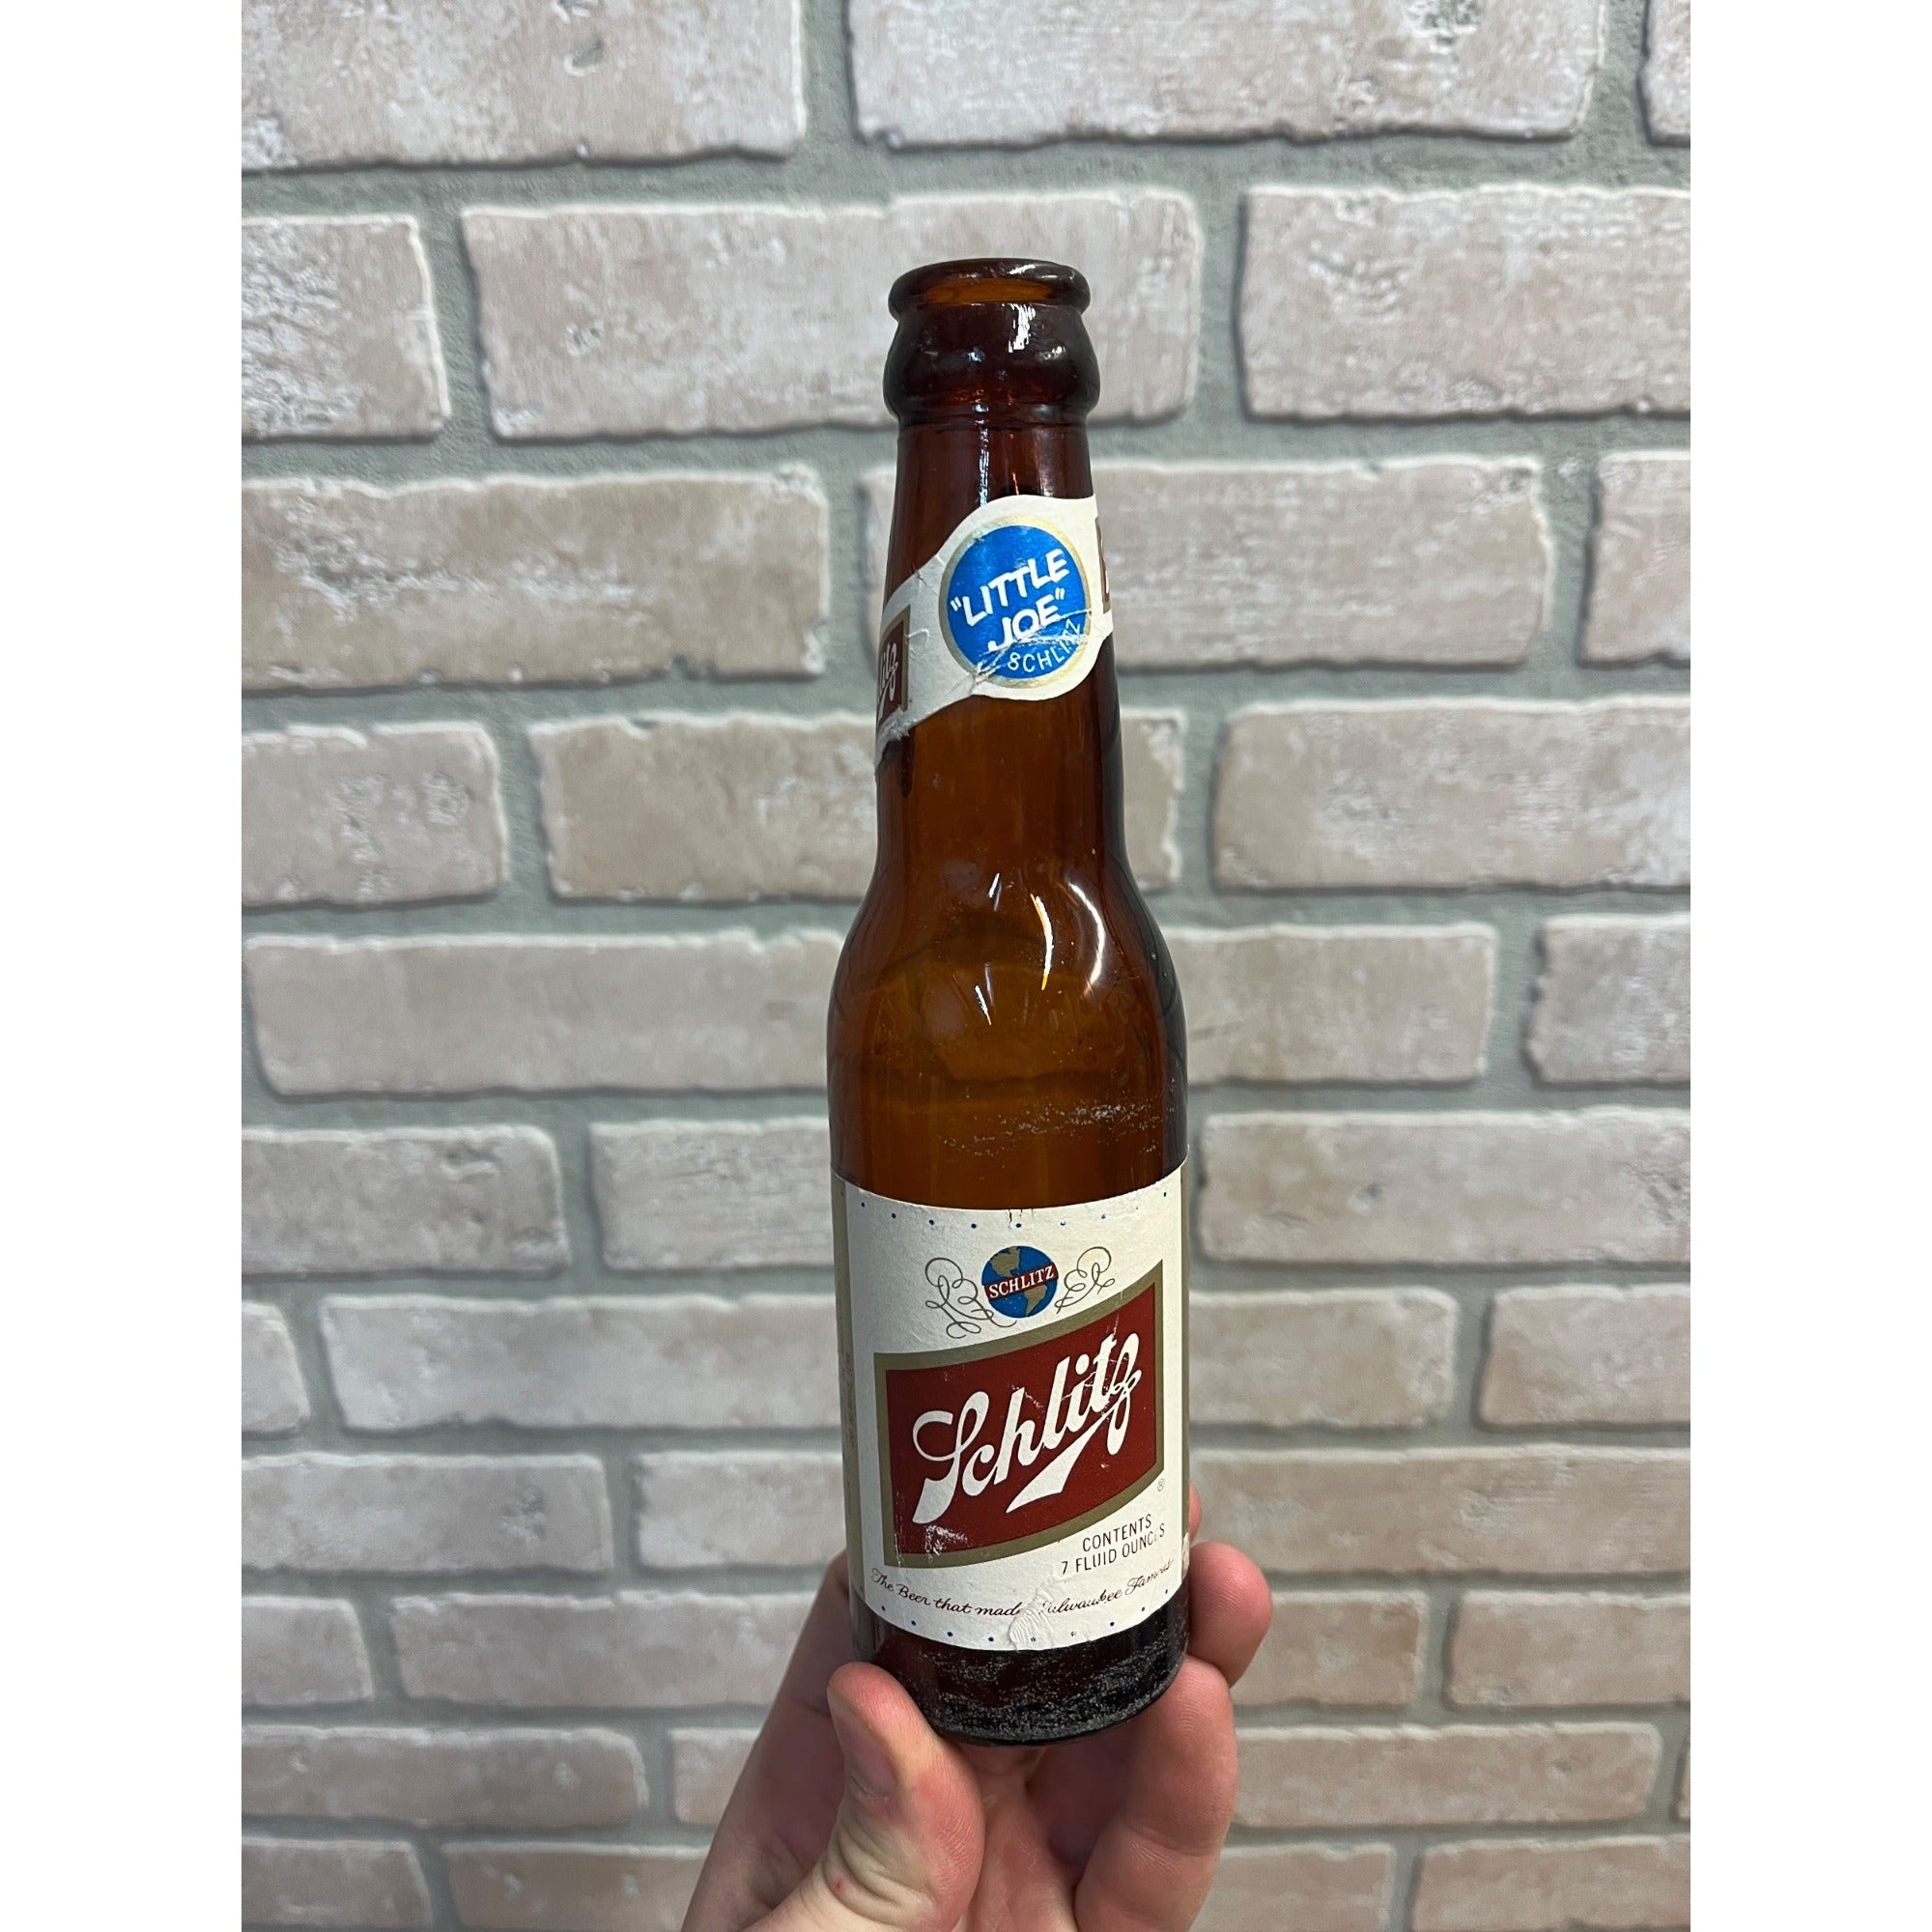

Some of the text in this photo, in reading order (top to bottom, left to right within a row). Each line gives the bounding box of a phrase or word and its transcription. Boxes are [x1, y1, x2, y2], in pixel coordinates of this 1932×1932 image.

[950, 548, 1070, 627] "LITTLE
[987, 587, 1065, 653] JOE"
[987, 1264, 1056, 1299] SCHLITZ
[911, 1332, 1143, 1524] Schlitz
[1061, 1522, 1166, 1576] 7 FLUID OUNCS
[1082, 1513, 1152, 1552] CONTENTS
[871, 1567, 895, 1593] The
[895, 1583, 932, 1606] Beer
[933, 1597, 974, 1614] that
[974, 1601, 1024, 1617] mad
